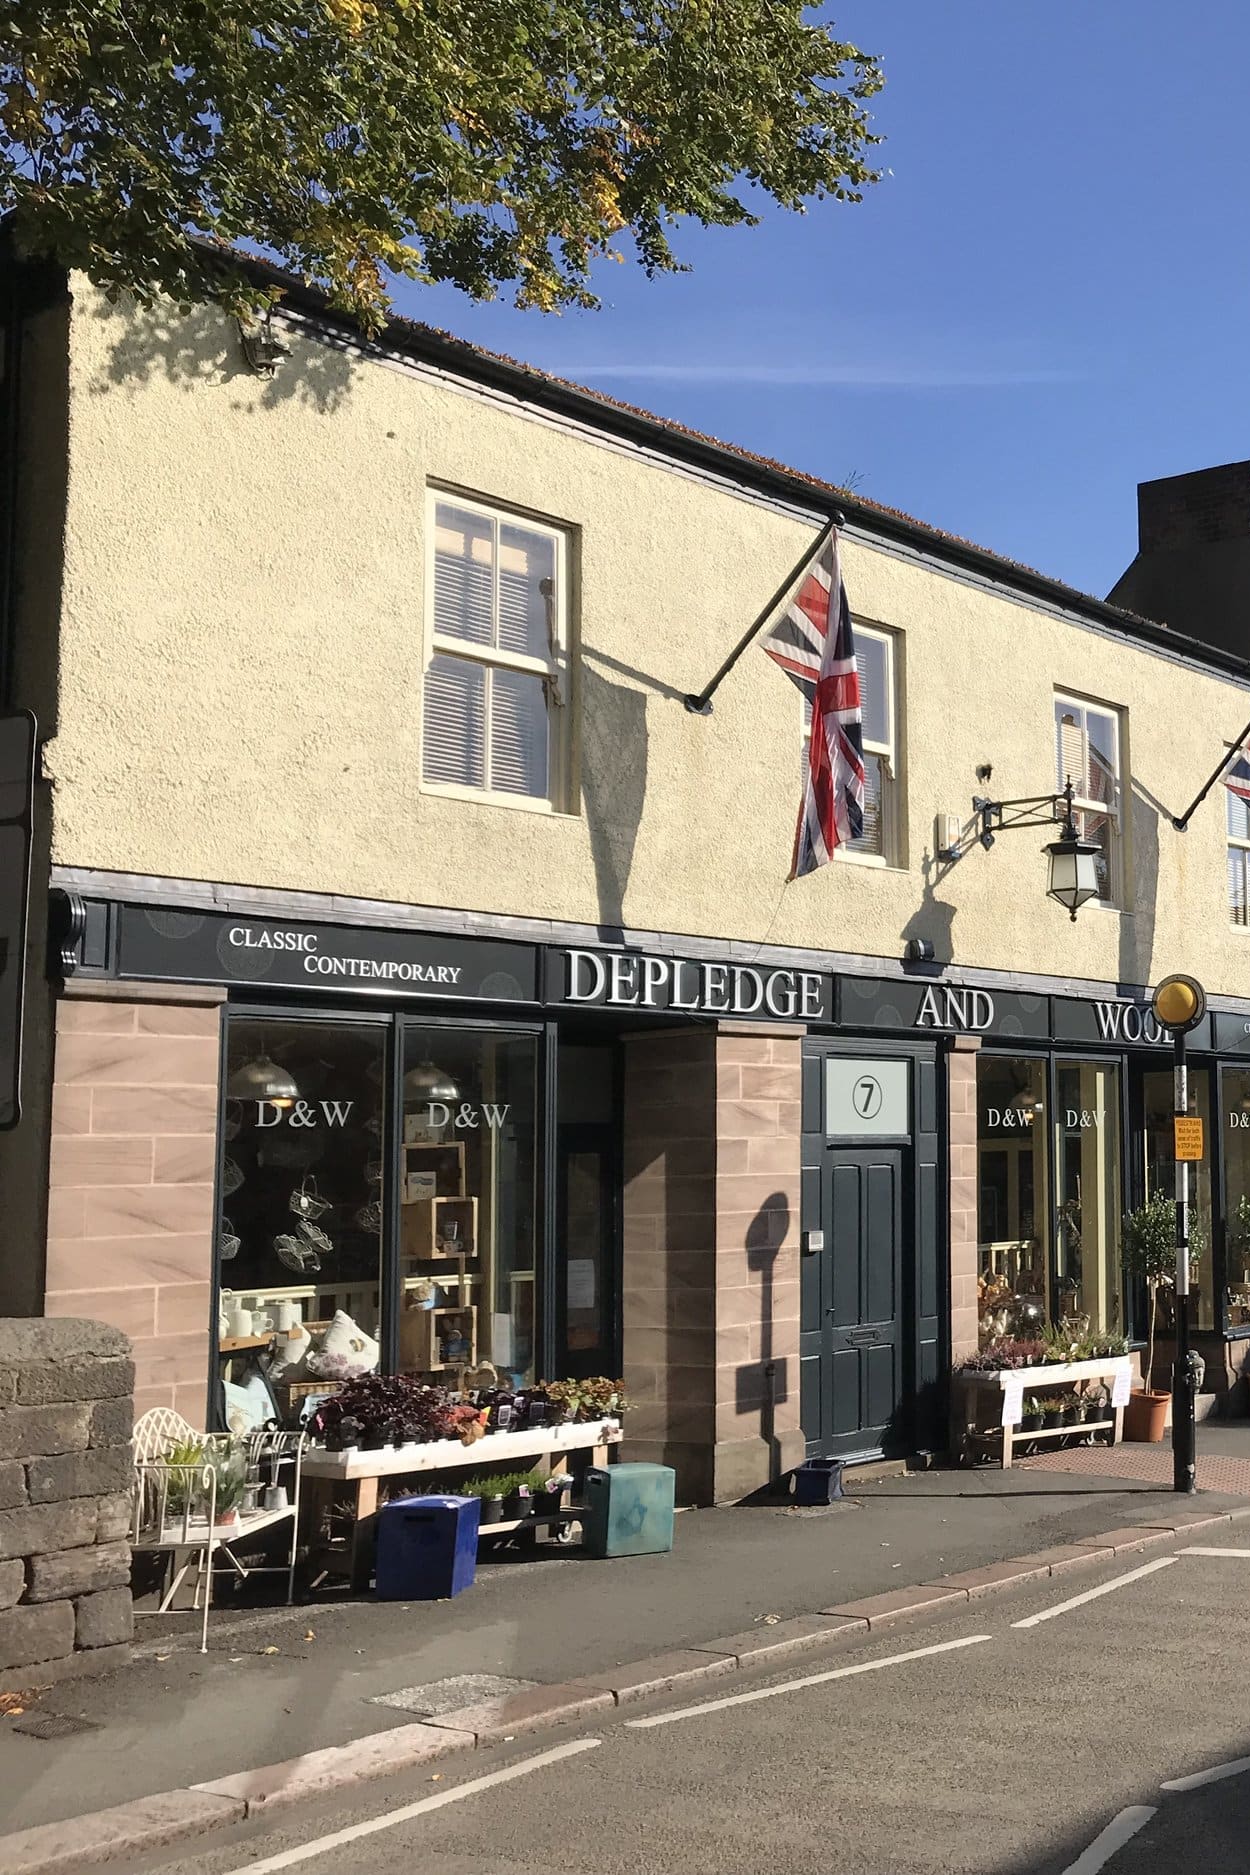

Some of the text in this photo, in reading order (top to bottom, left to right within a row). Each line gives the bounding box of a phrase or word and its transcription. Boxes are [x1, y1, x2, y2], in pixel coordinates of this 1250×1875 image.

[229, 927, 318, 953] CLASSIC
[303, 955, 463, 985] CONTEMPORARY
[565, 949, 825, 1019] DEPLEDGE
[914, 985, 995, 1031] AND
[859, 1082, 875, 1113] 7
[256, 1100, 354, 1129] D&W
[426, 1101, 510, 1129] D&W
[987, 1108, 1033, 1127] D&W
